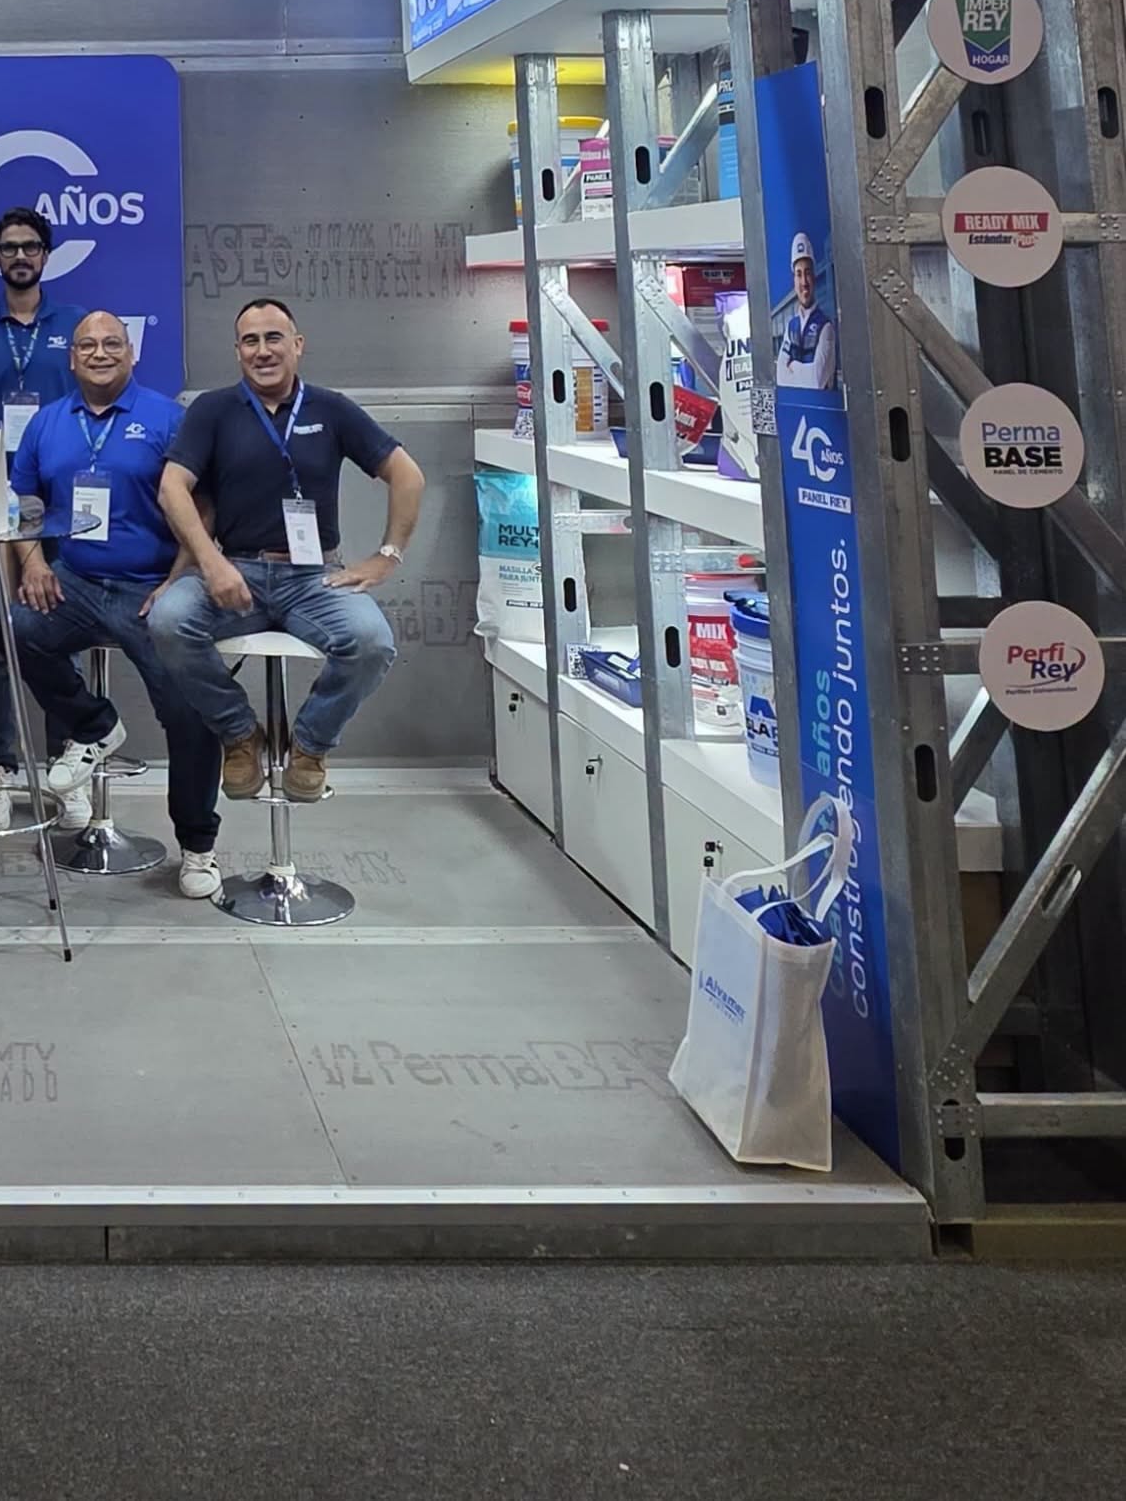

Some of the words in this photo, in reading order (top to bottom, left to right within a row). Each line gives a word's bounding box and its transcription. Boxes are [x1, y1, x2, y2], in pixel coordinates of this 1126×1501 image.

[962, 10, 1009, 32] REY
[972, 54, 1010, 65] HOGAR
[34, 185, 145, 226] AÑOS
[965, 215, 1008, 230] READY
[1013, 215, 1040, 230] MIX
[981, 422, 1061, 442] Perma
[821, 448, 844, 465] AÑOS
[984, 446, 1062, 468] BASE
[801, 490, 829, 506] PANEL
[829, 495, 848, 509] REY
[499, 523, 539, 536] MULT
[831, 537, 858, 692] juntos.
[696, 622, 727, 639] MIX
[1006, 642, 1066, 664] Perfi
[1030, 660, 1076, 683] Rey
[812, 670, 831, 777] años
